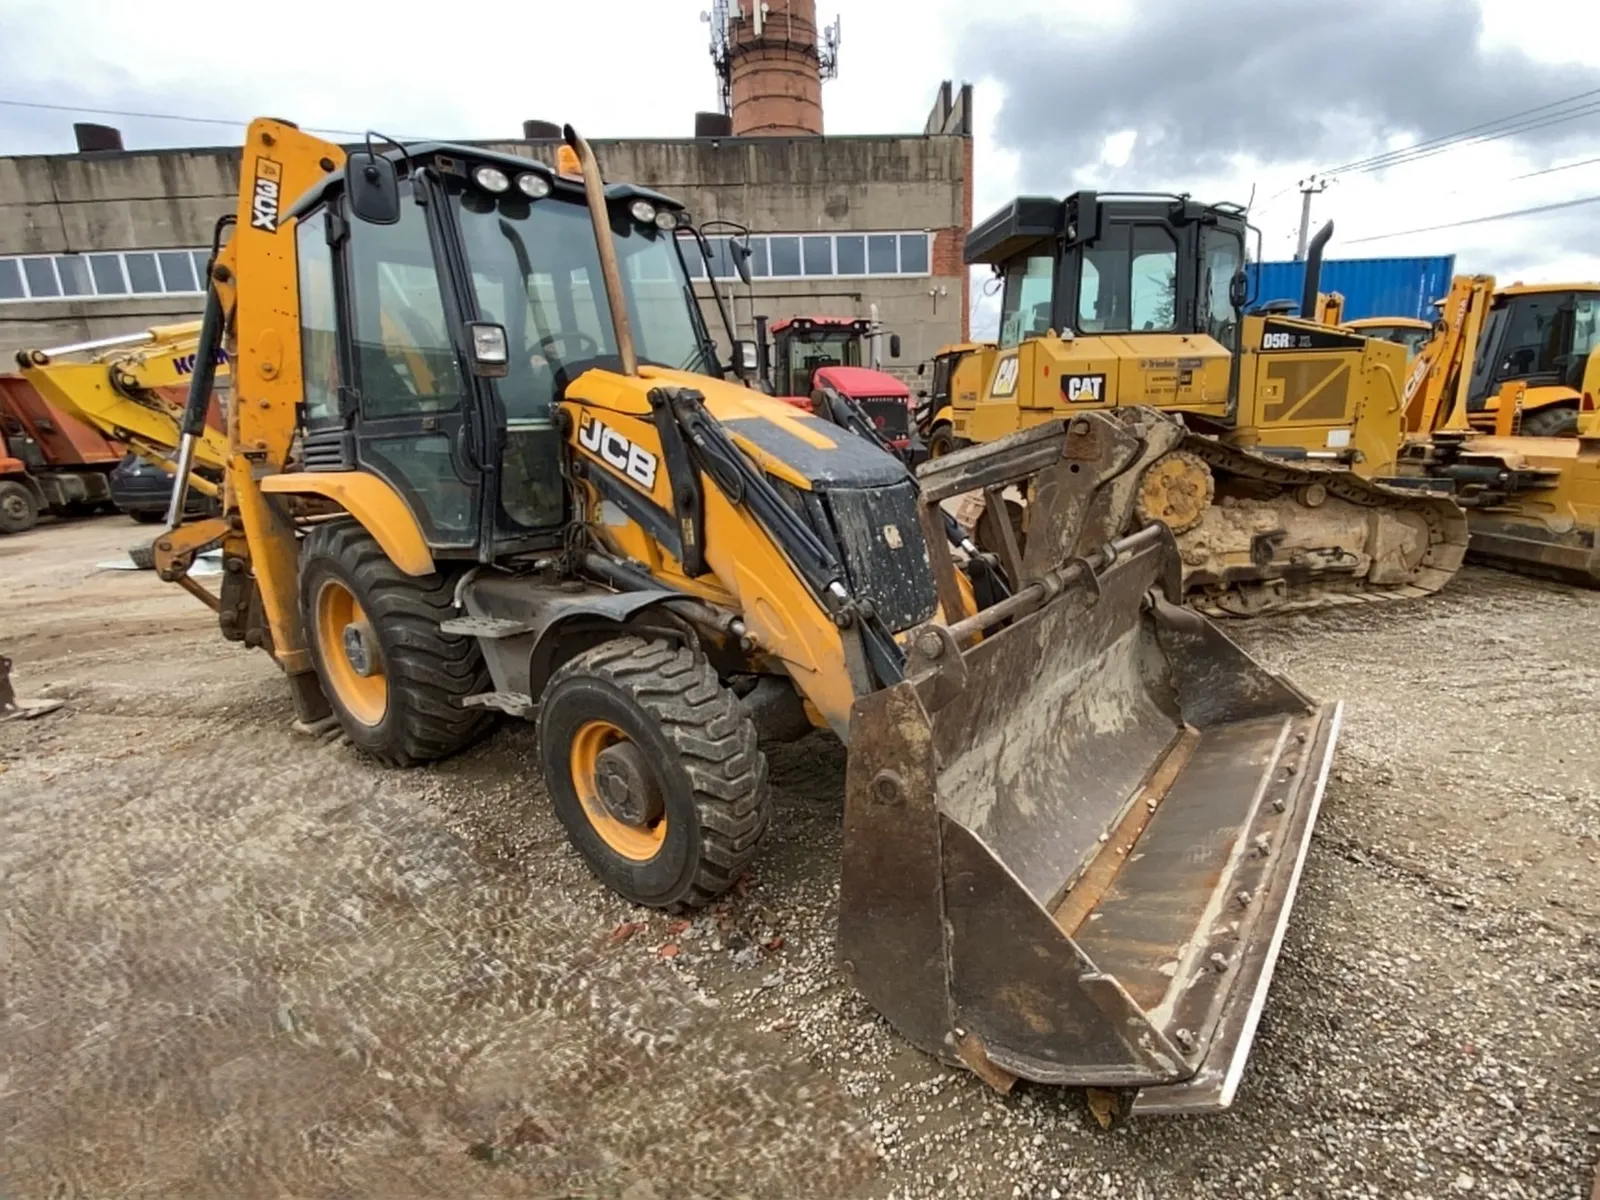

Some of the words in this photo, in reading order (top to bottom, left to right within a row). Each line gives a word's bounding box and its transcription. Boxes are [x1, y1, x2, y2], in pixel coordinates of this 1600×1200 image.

[252, 179, 278, 231] 3CX
[1068, 377, 1103, 401] CAT
[579, 419, 657, 489] JCB
